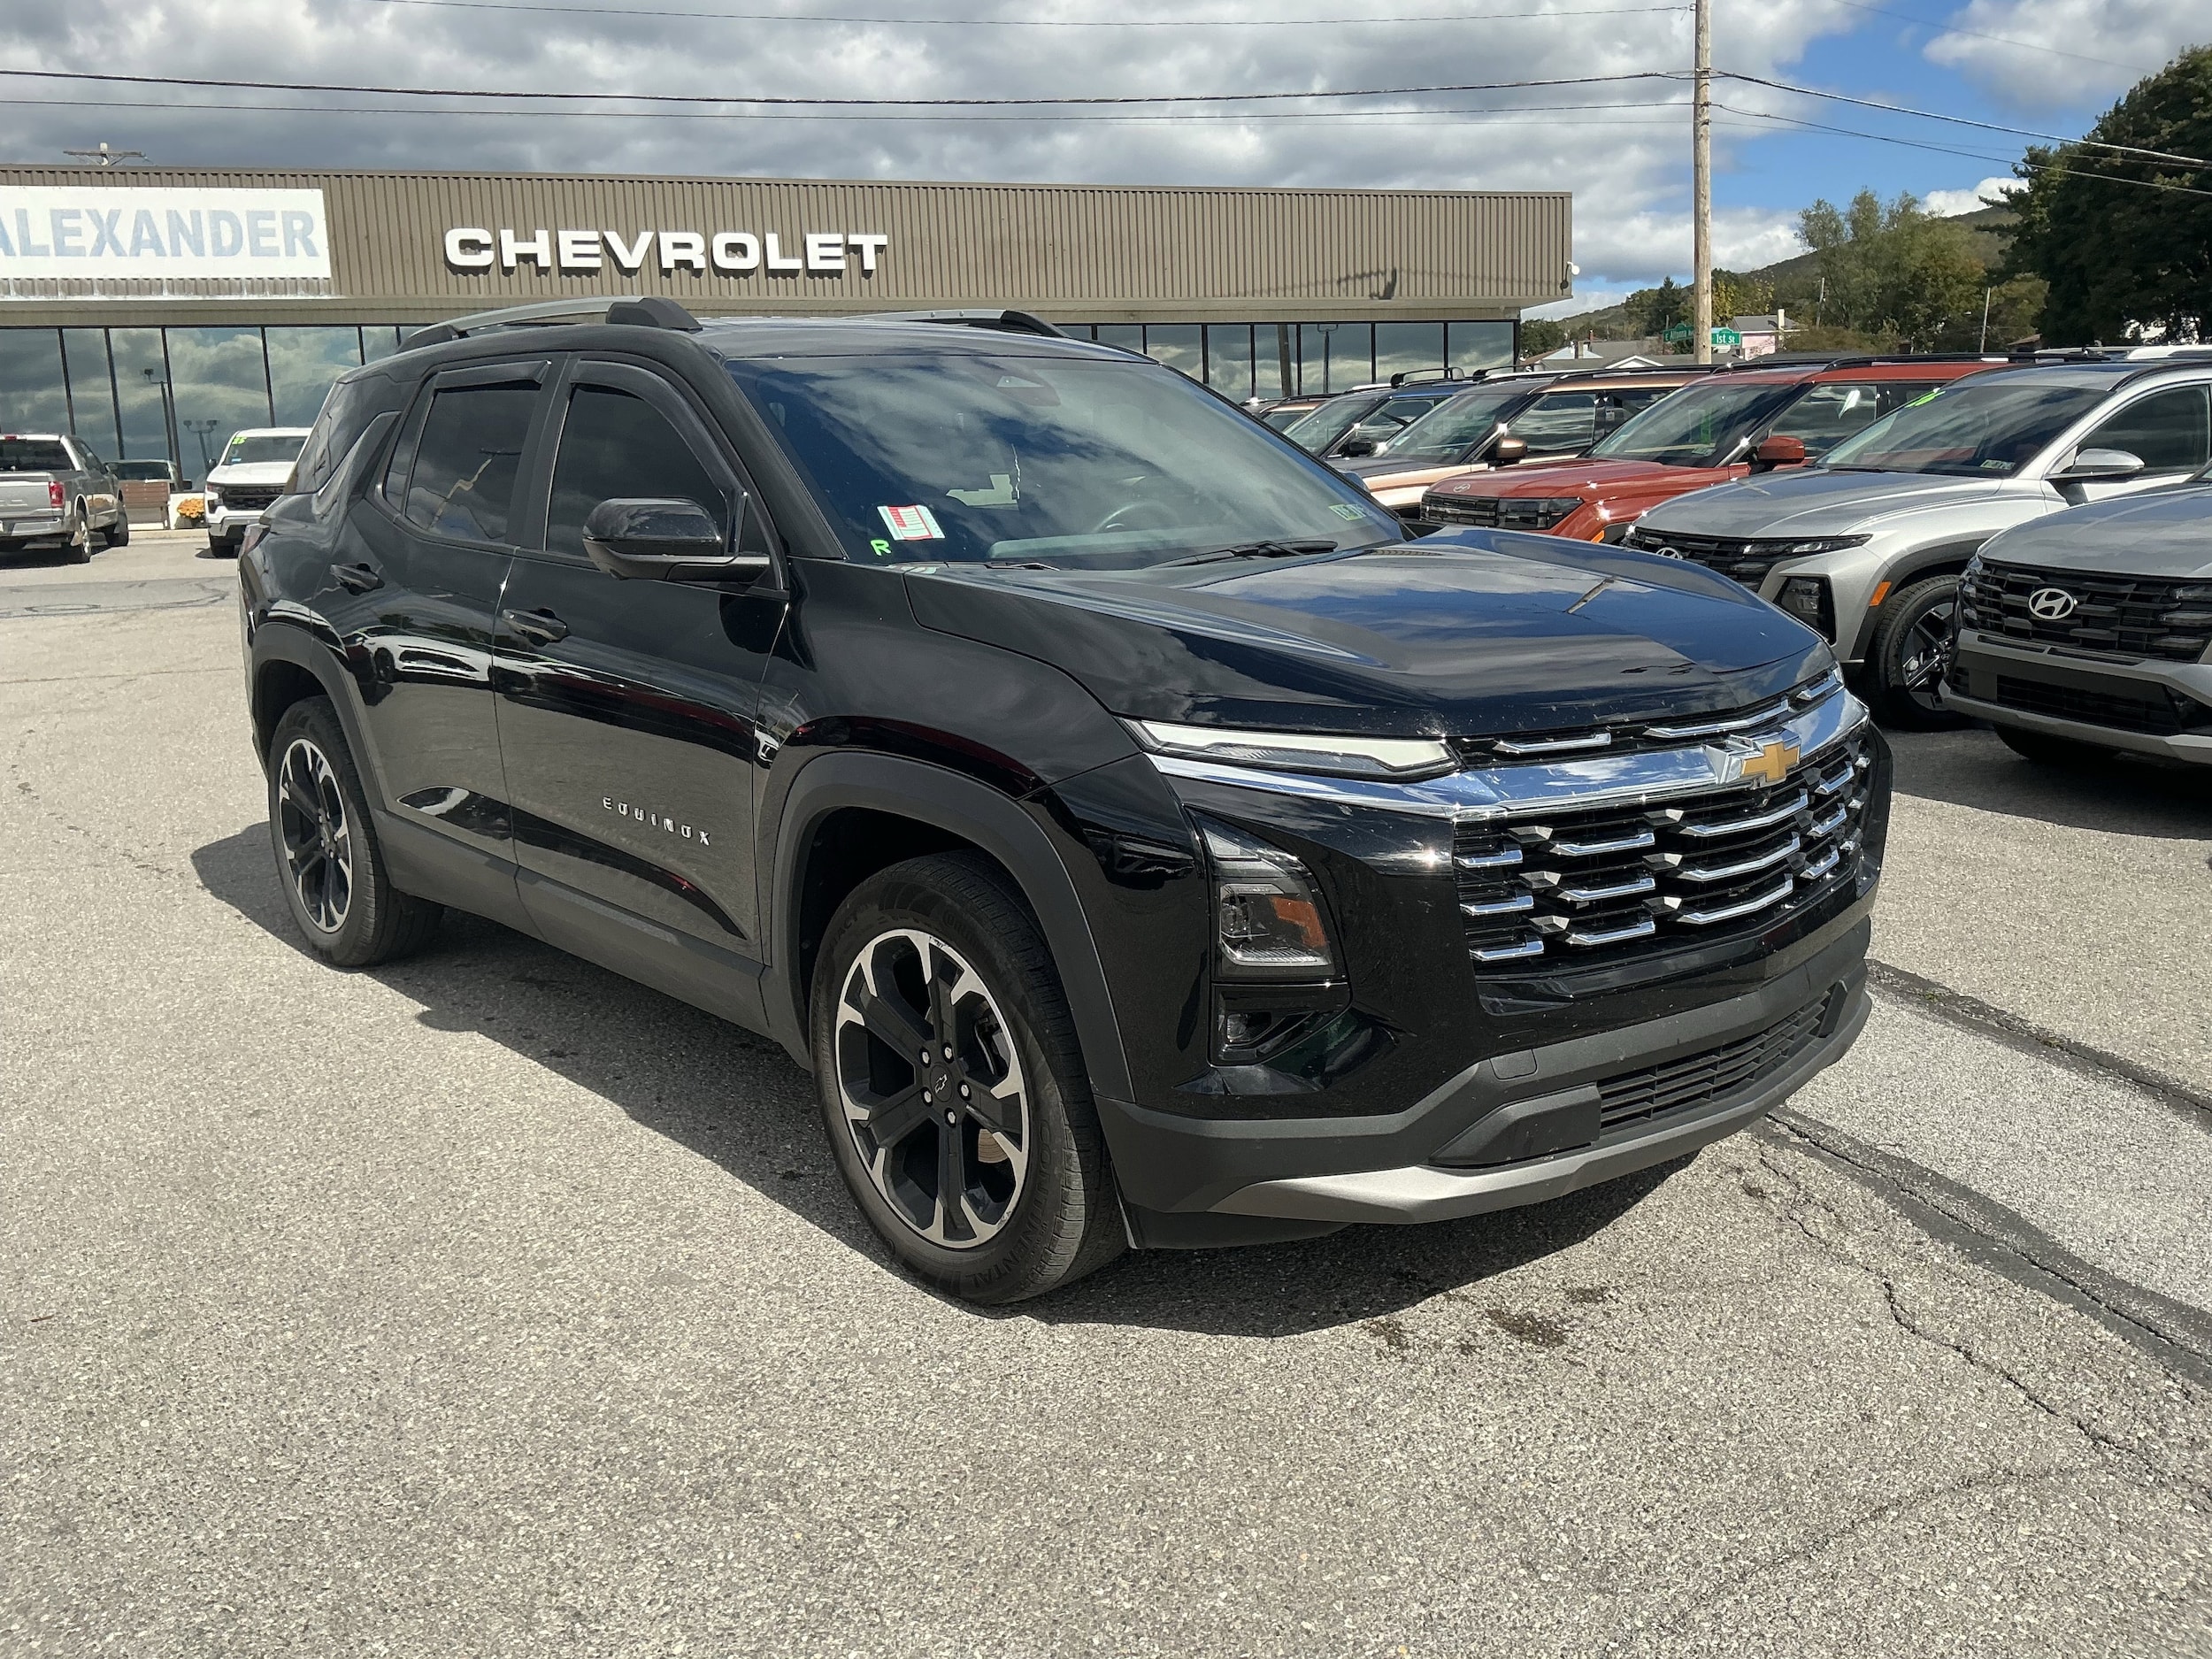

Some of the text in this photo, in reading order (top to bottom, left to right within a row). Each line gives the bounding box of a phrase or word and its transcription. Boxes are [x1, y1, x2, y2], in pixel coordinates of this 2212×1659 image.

[444, 227, 888, 270] CHEVROLET
[1717, 334, 1726, 343] 1st
[870, 539, 892, 557] R
[602, 796, 710, 846] EQUINOX
